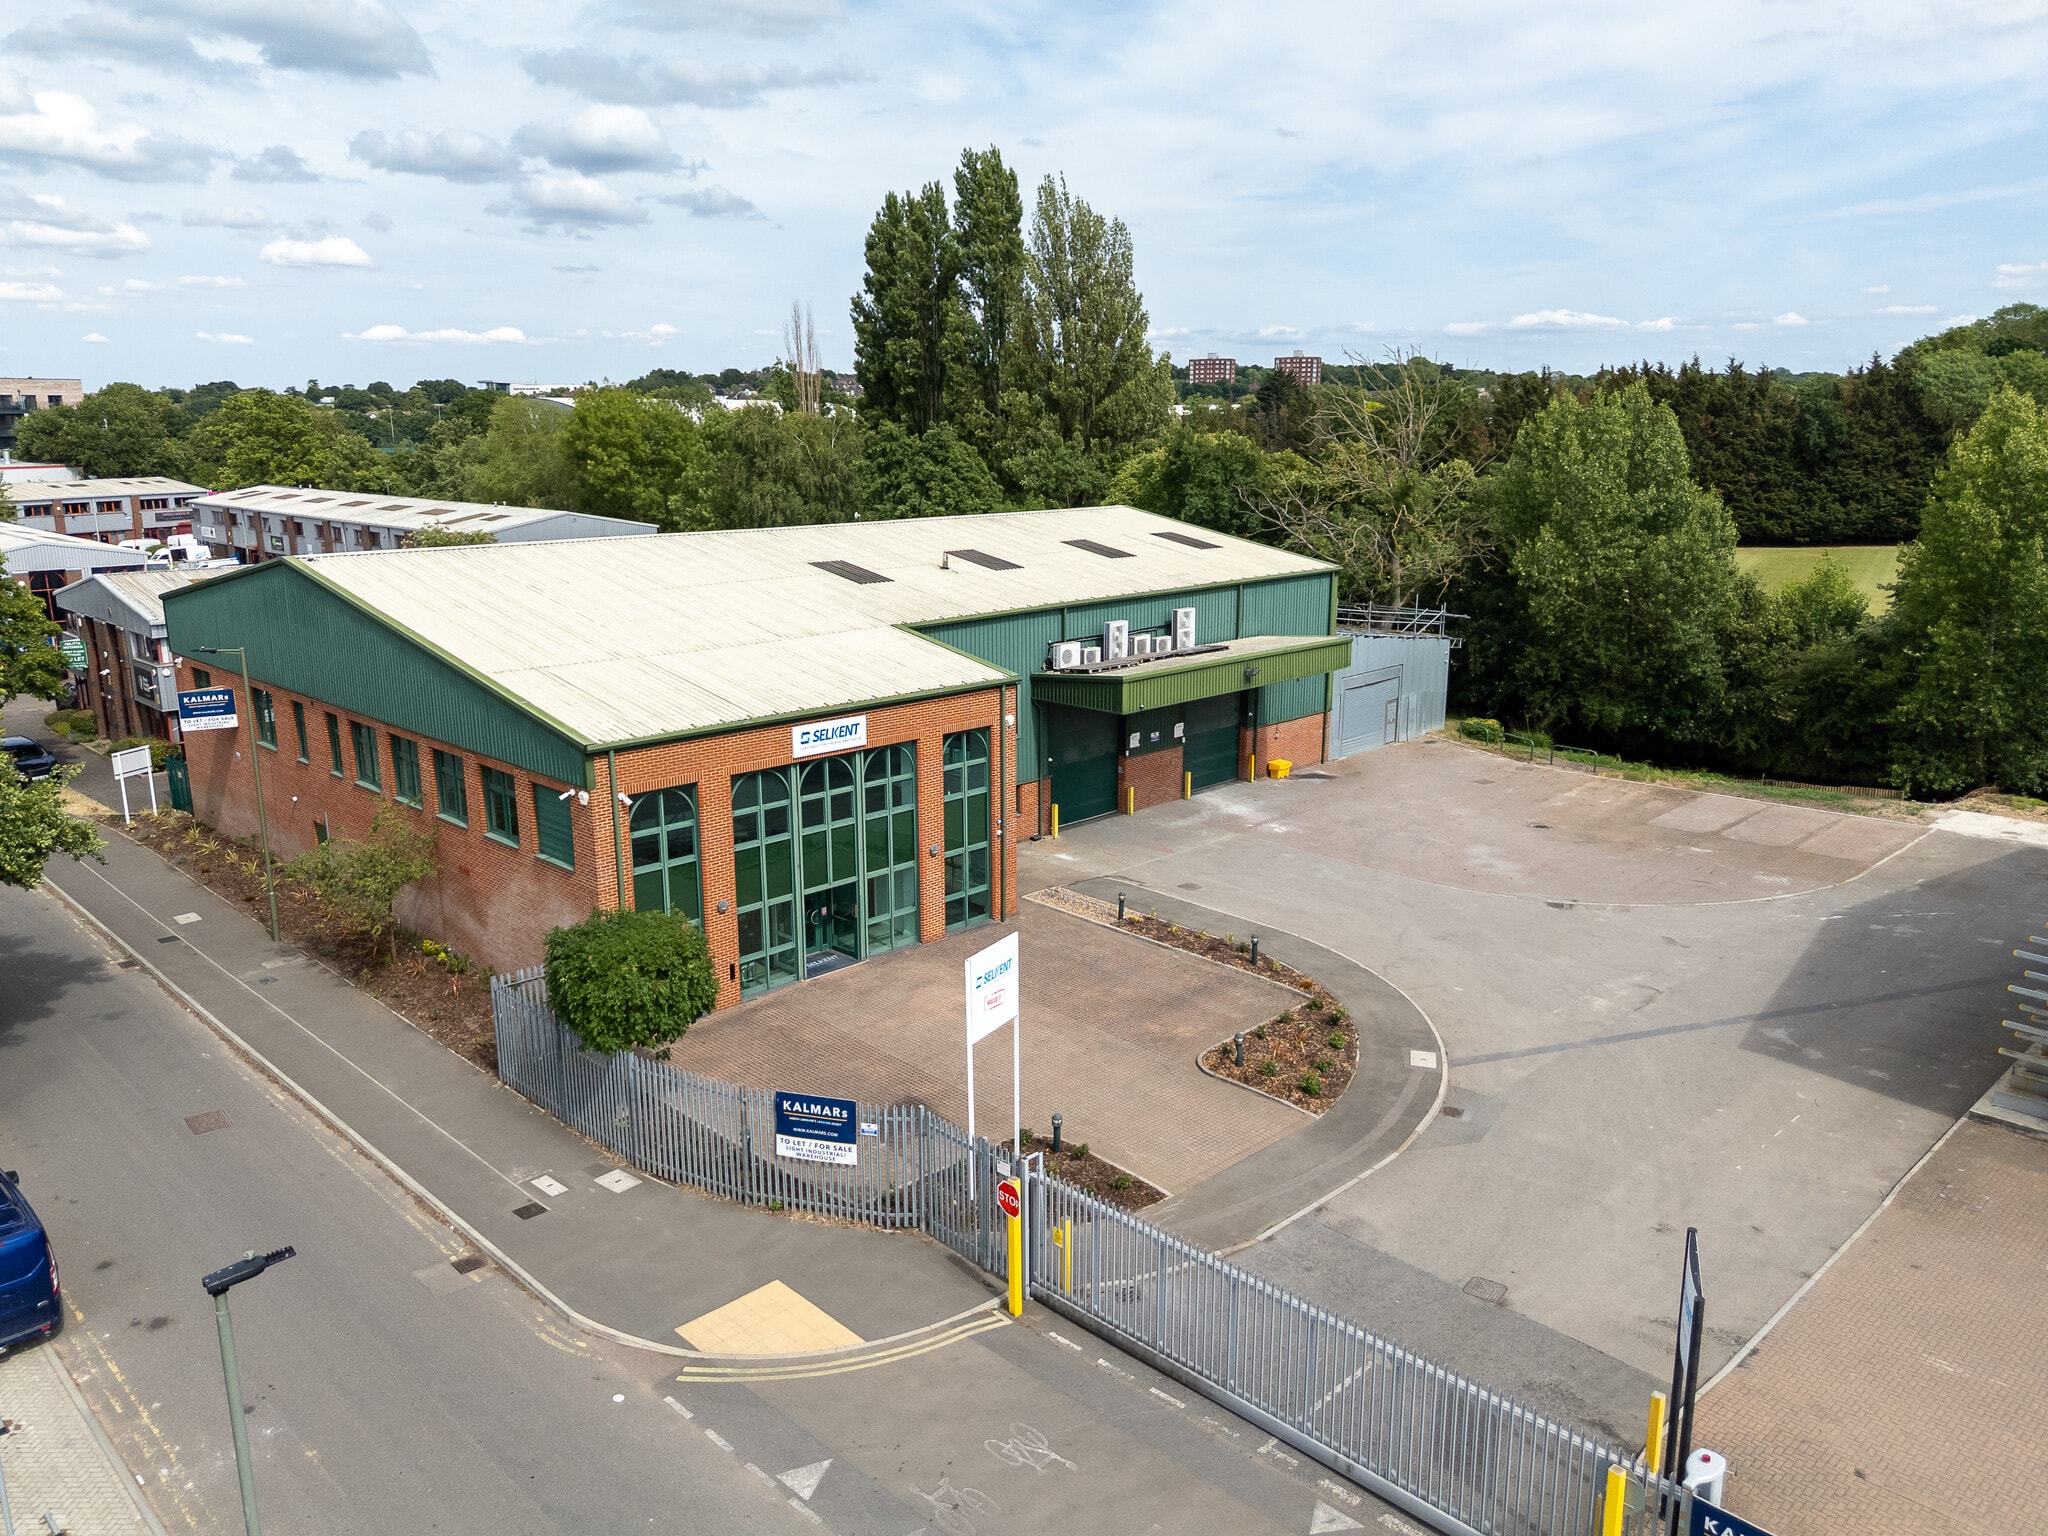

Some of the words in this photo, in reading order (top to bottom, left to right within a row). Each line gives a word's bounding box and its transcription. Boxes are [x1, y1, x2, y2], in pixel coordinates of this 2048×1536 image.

[813, 723, 860, 742] SELKENT
[984, 958, 1012, 984] SELKENT
[793, 1128, 838, 1137] WWW.KALMARS.COM
[796, 1152, 836, 1161] WAREHOUSE
[1000, 1190, 1018, 1208] STOP
